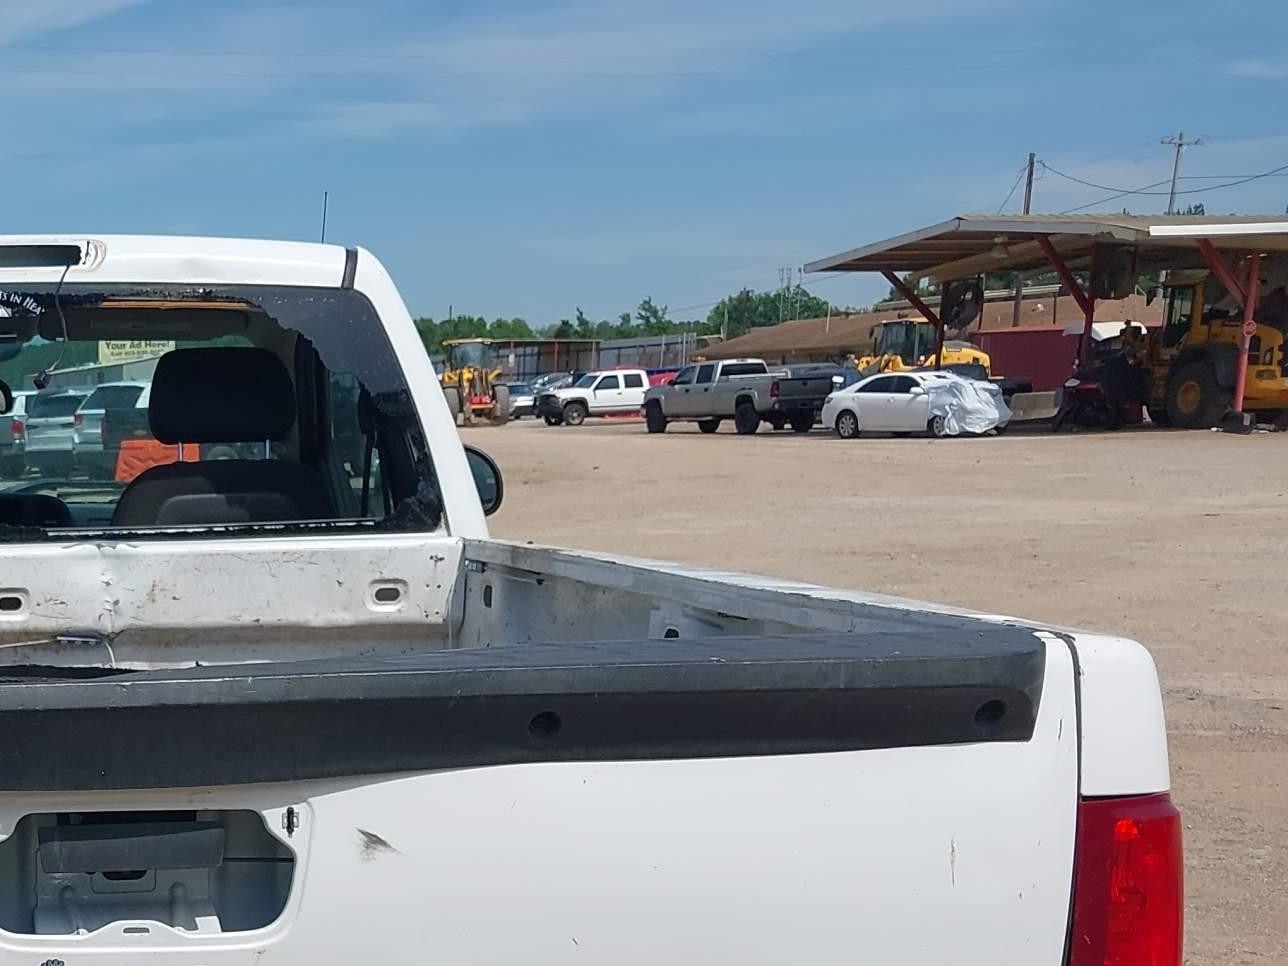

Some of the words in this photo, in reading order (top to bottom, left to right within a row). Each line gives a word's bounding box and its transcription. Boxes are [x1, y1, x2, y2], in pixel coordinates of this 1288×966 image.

[9, 293, 22, 304] IN
[22, 296, 45, 315] HEA
[105, 342, 127, 350] Your
